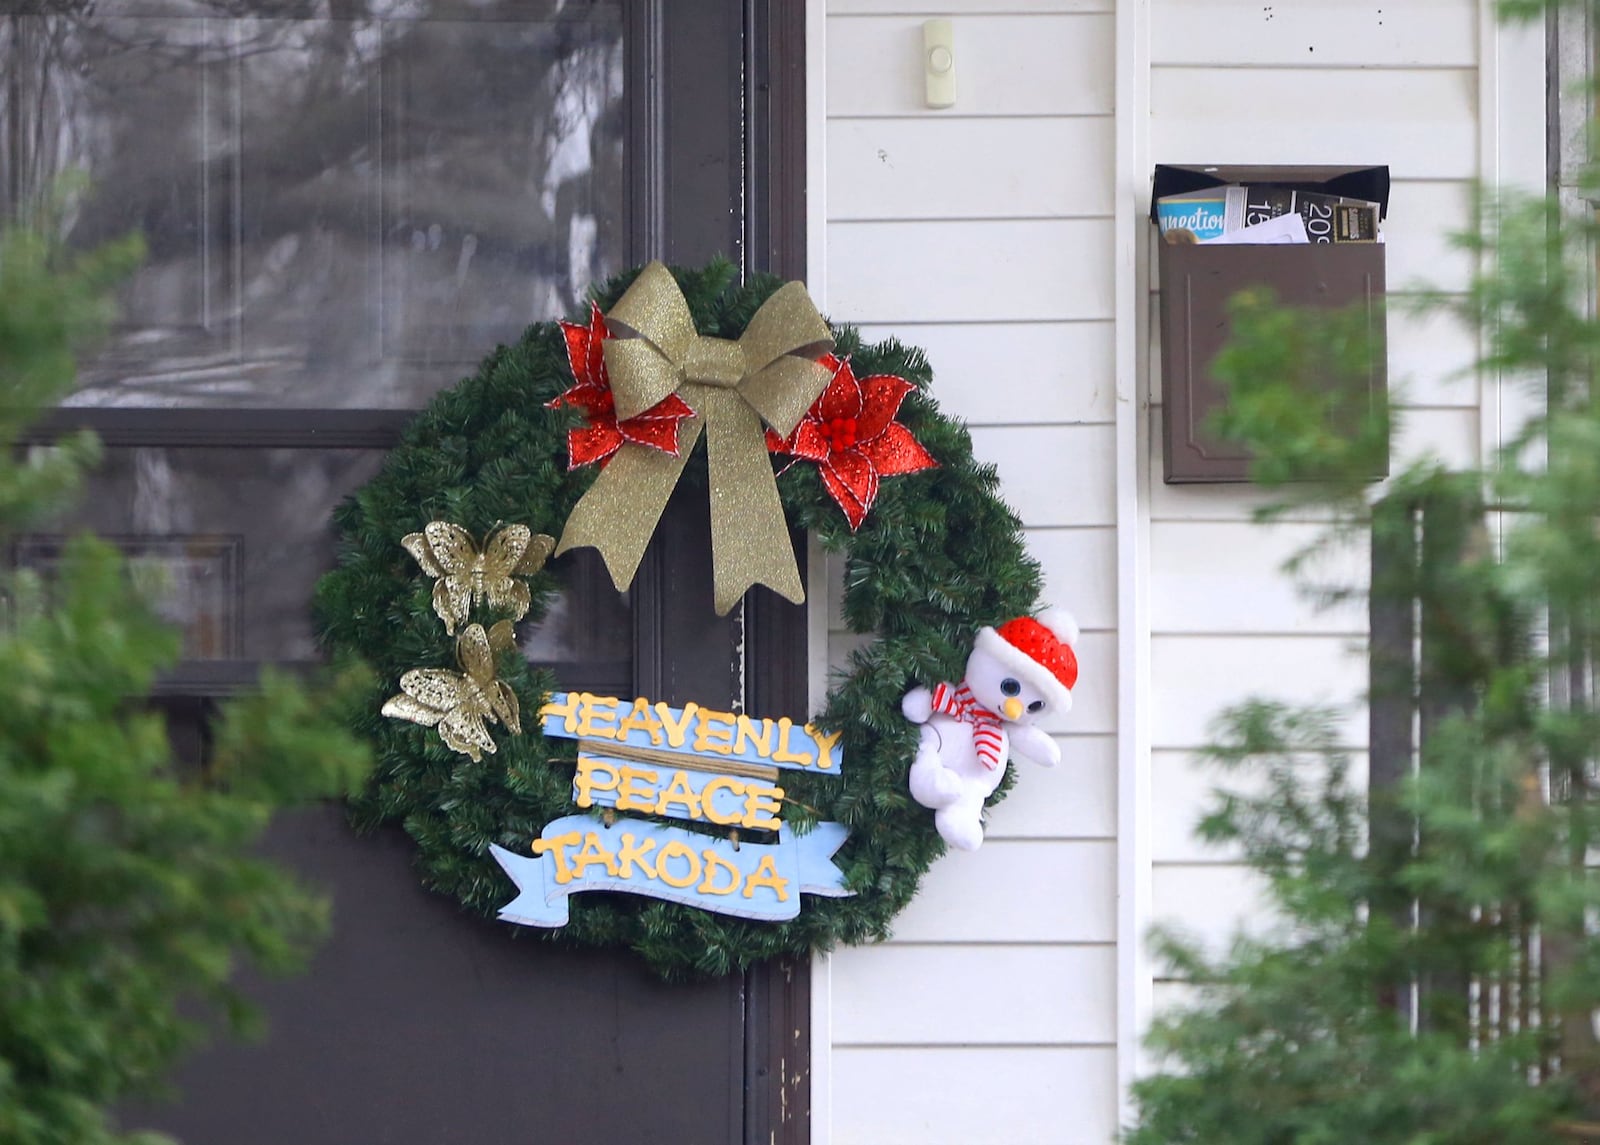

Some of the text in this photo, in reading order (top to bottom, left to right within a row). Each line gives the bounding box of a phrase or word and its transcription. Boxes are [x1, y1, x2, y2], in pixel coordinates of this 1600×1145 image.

[537, 691, 844, 768] HEAVENLY
[576, 757, 785, 830] PEACE
[531, 831, 790, 902] TAKODA
